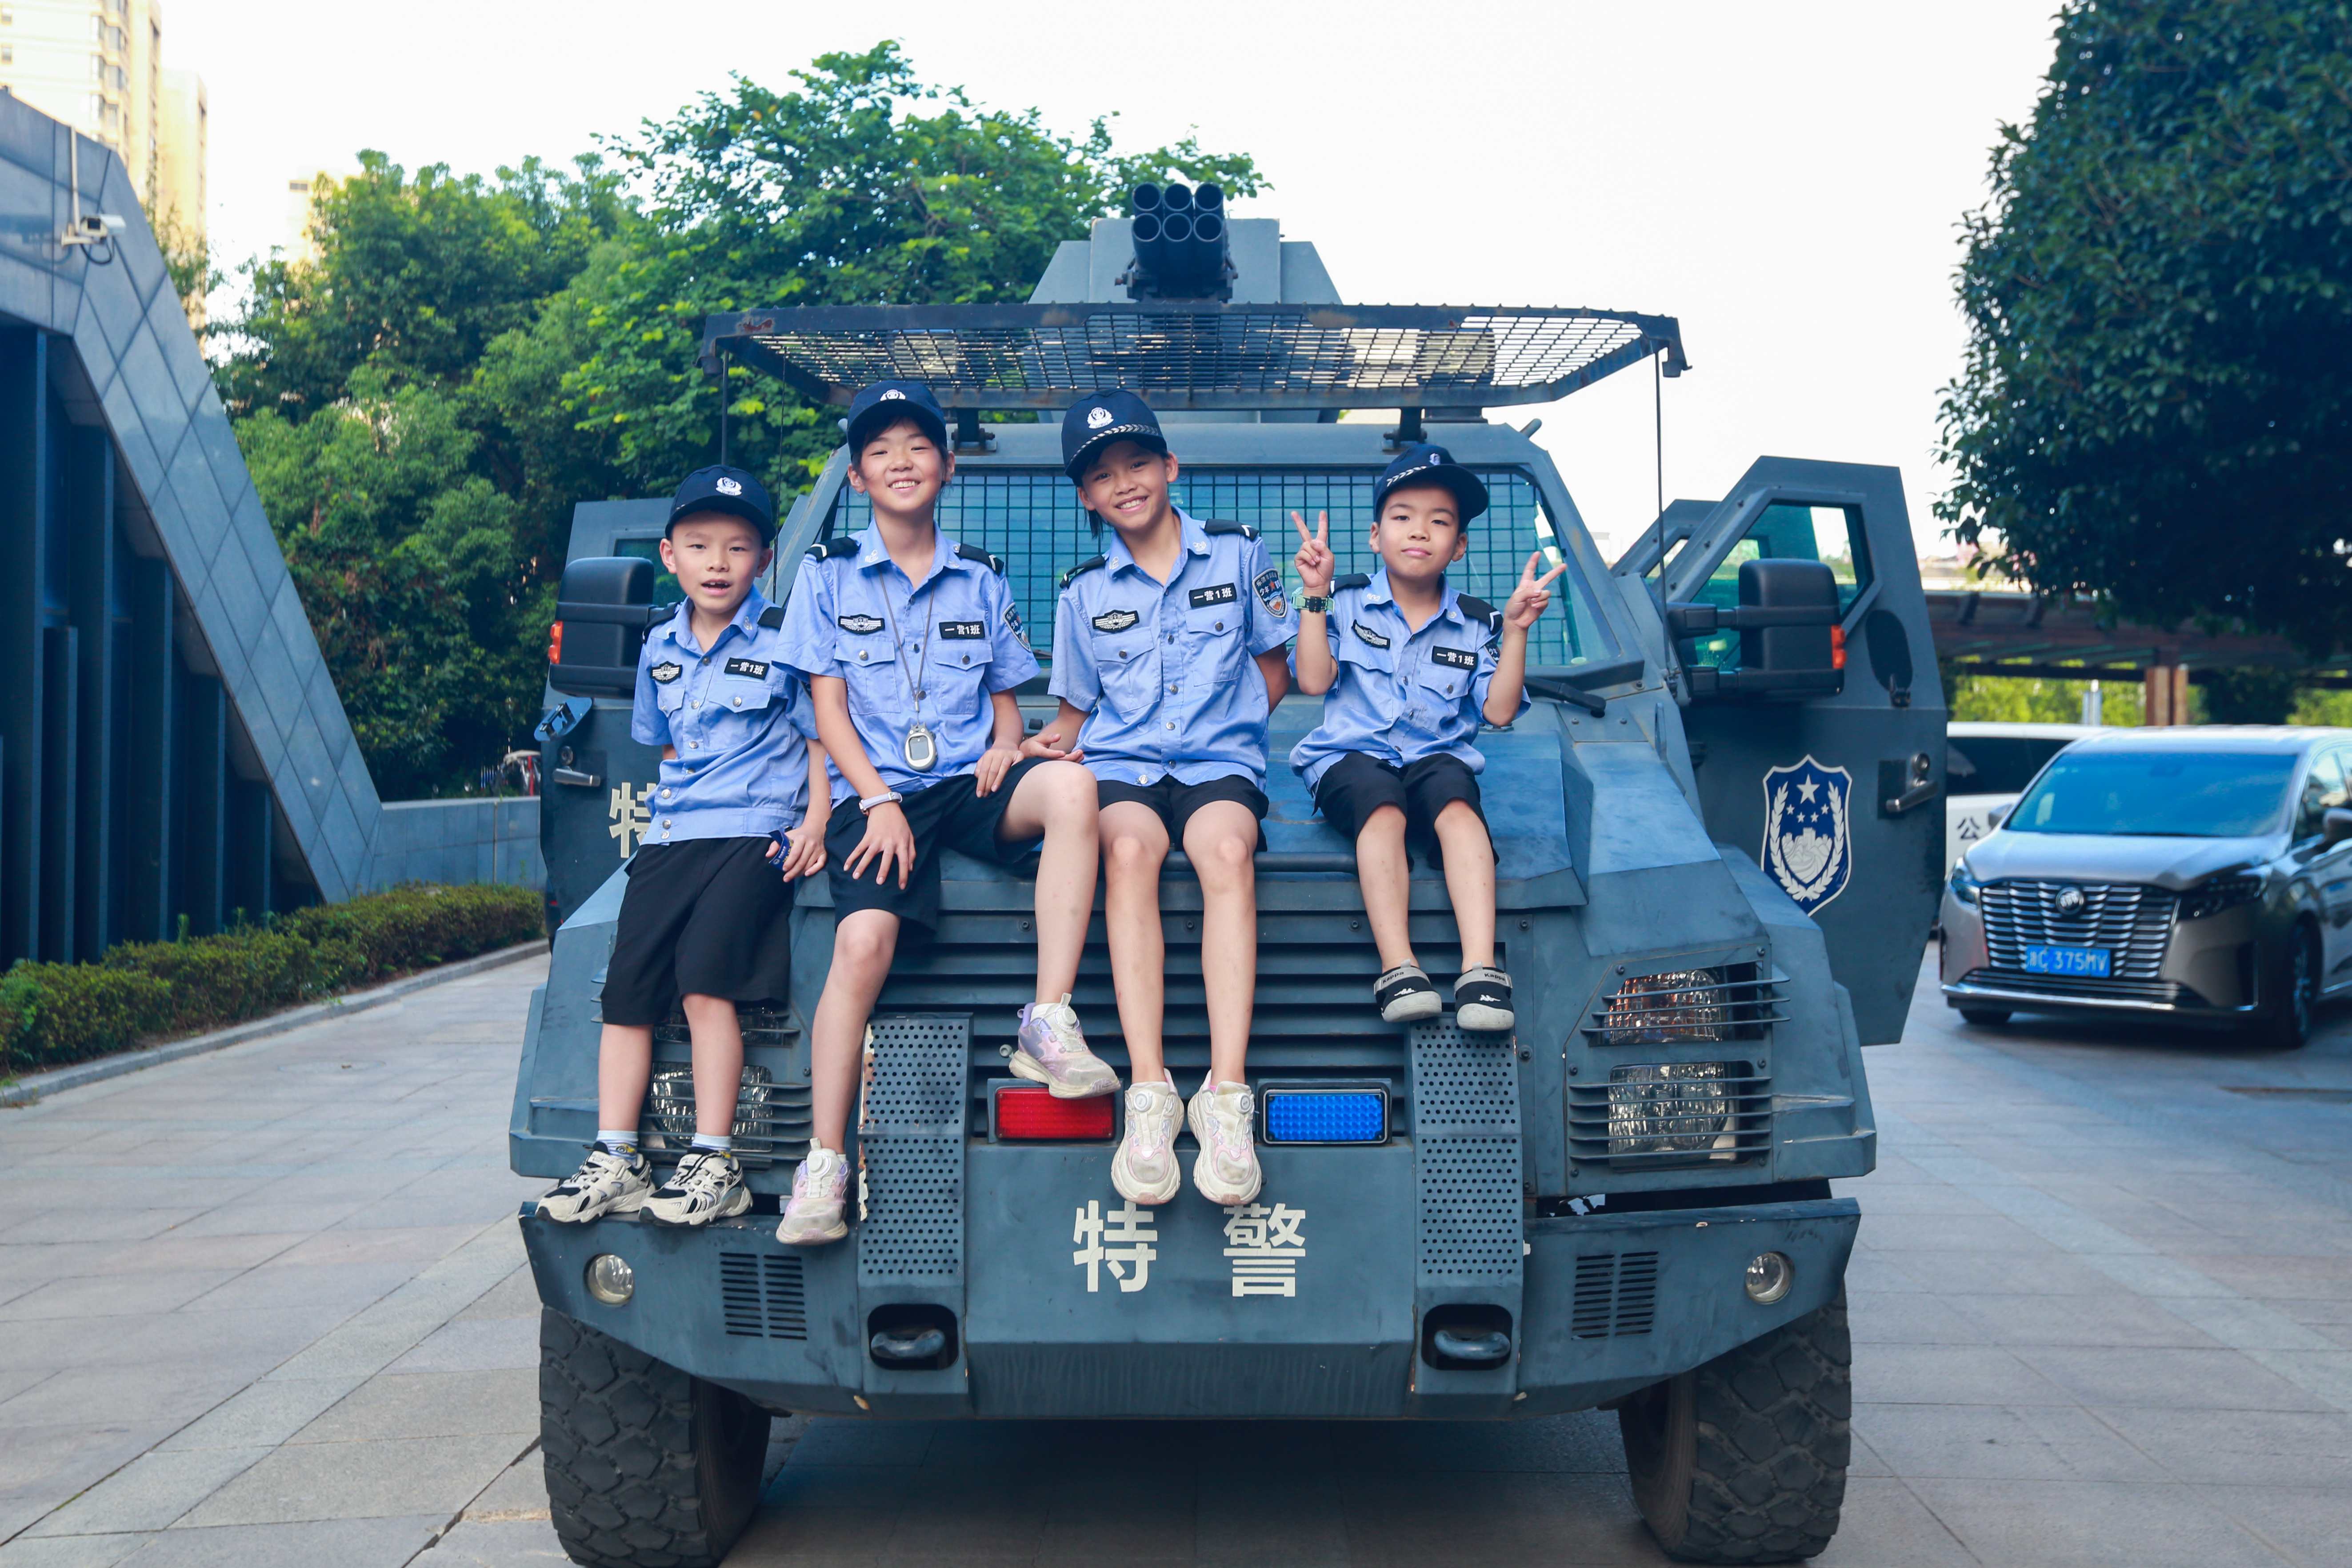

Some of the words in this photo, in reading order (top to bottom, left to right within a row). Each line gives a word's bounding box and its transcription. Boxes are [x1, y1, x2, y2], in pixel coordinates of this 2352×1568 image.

[1193, 587, 1233, 601] 一营1班
[944, 624, 981, 635] 一营1班
[1436, 652, 1474, 666] 一营1班
[730, 661, 764, 675] 一营1班
[1957, 816, 1980, 840] 公
[1073, 1200, 1306, 1297] 特警
